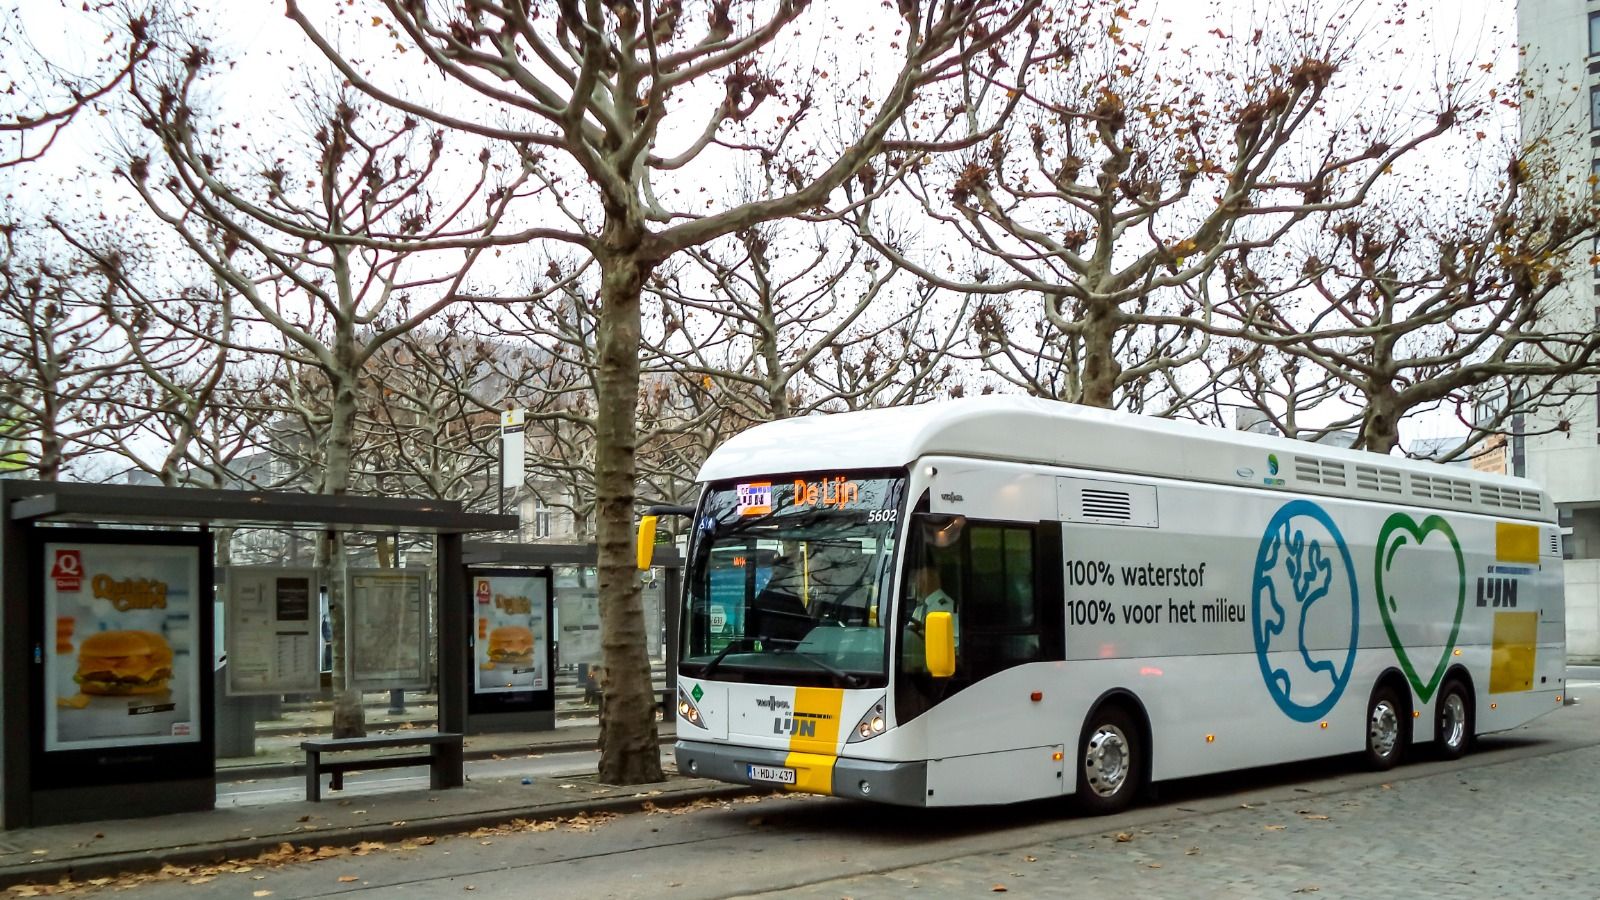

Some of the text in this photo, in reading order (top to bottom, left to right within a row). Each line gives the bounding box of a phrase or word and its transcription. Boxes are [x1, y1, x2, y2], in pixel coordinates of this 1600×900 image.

[794, 476, 859, 511] De Lijn
[868, 509, 897, 522] 5602
[59, 555, 79, 575] Q
[1066, 560, 1206, 587] 100% waterstof
[1476, 577, 1517, 607] LIJN
[1067, 598, 1246, 625] 100% voor het milieu
[774, 717, 816, 737] LIJN
